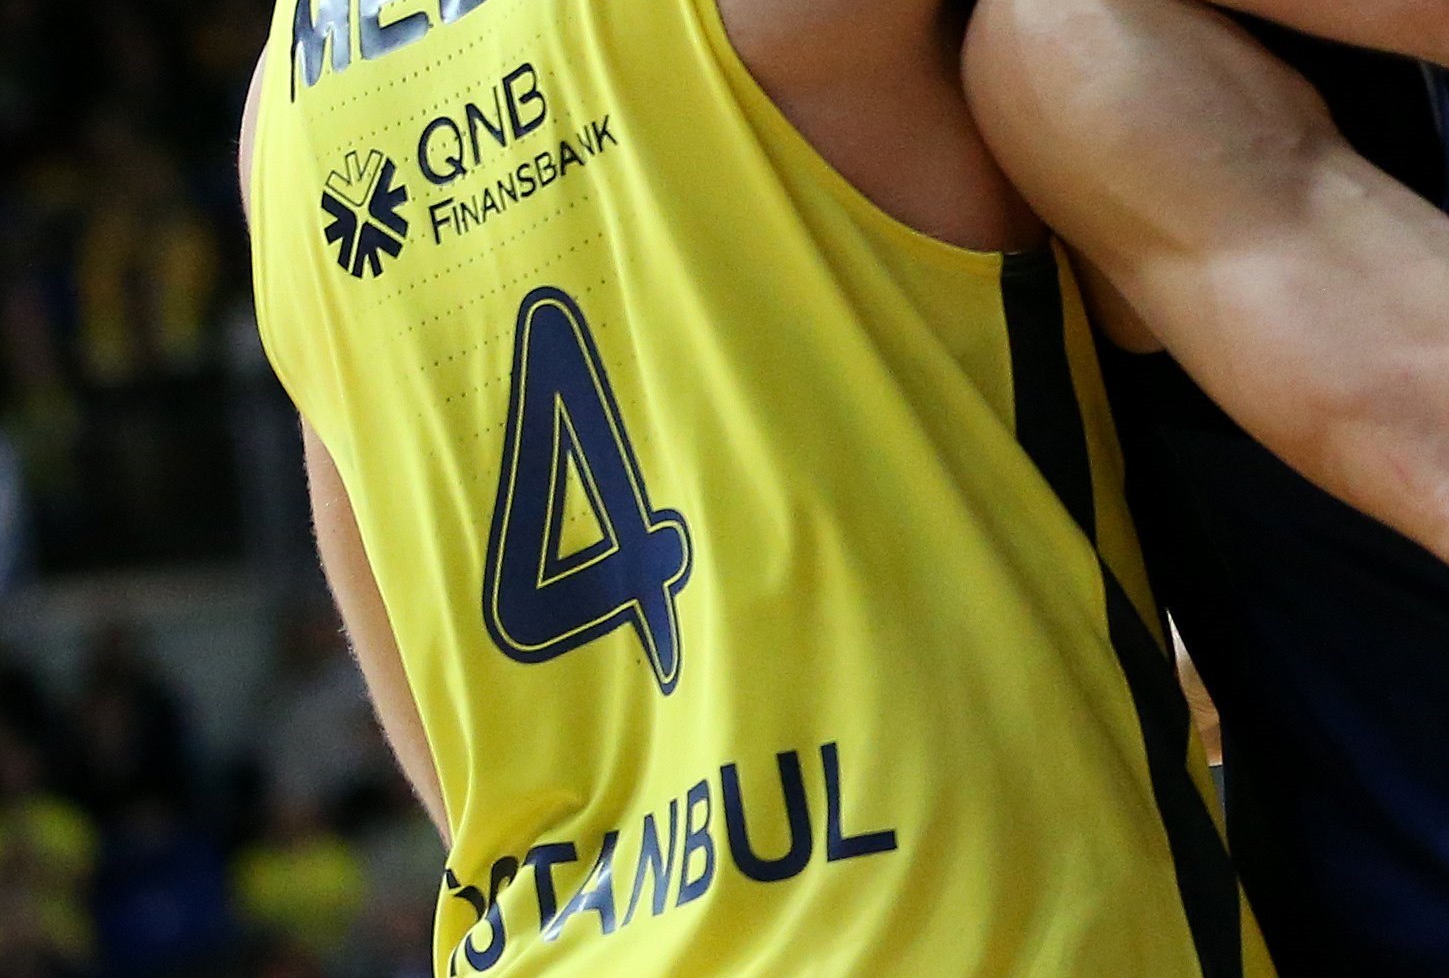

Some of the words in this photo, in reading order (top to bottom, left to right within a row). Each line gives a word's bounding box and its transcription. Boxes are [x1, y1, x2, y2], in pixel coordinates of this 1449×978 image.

[417, 62, 548, 185] QNB
[428, 114, 619, 245] FINANSBANK
[482, 285, 694, 696] 4
[445, 741, 898, 977] STANBUL
